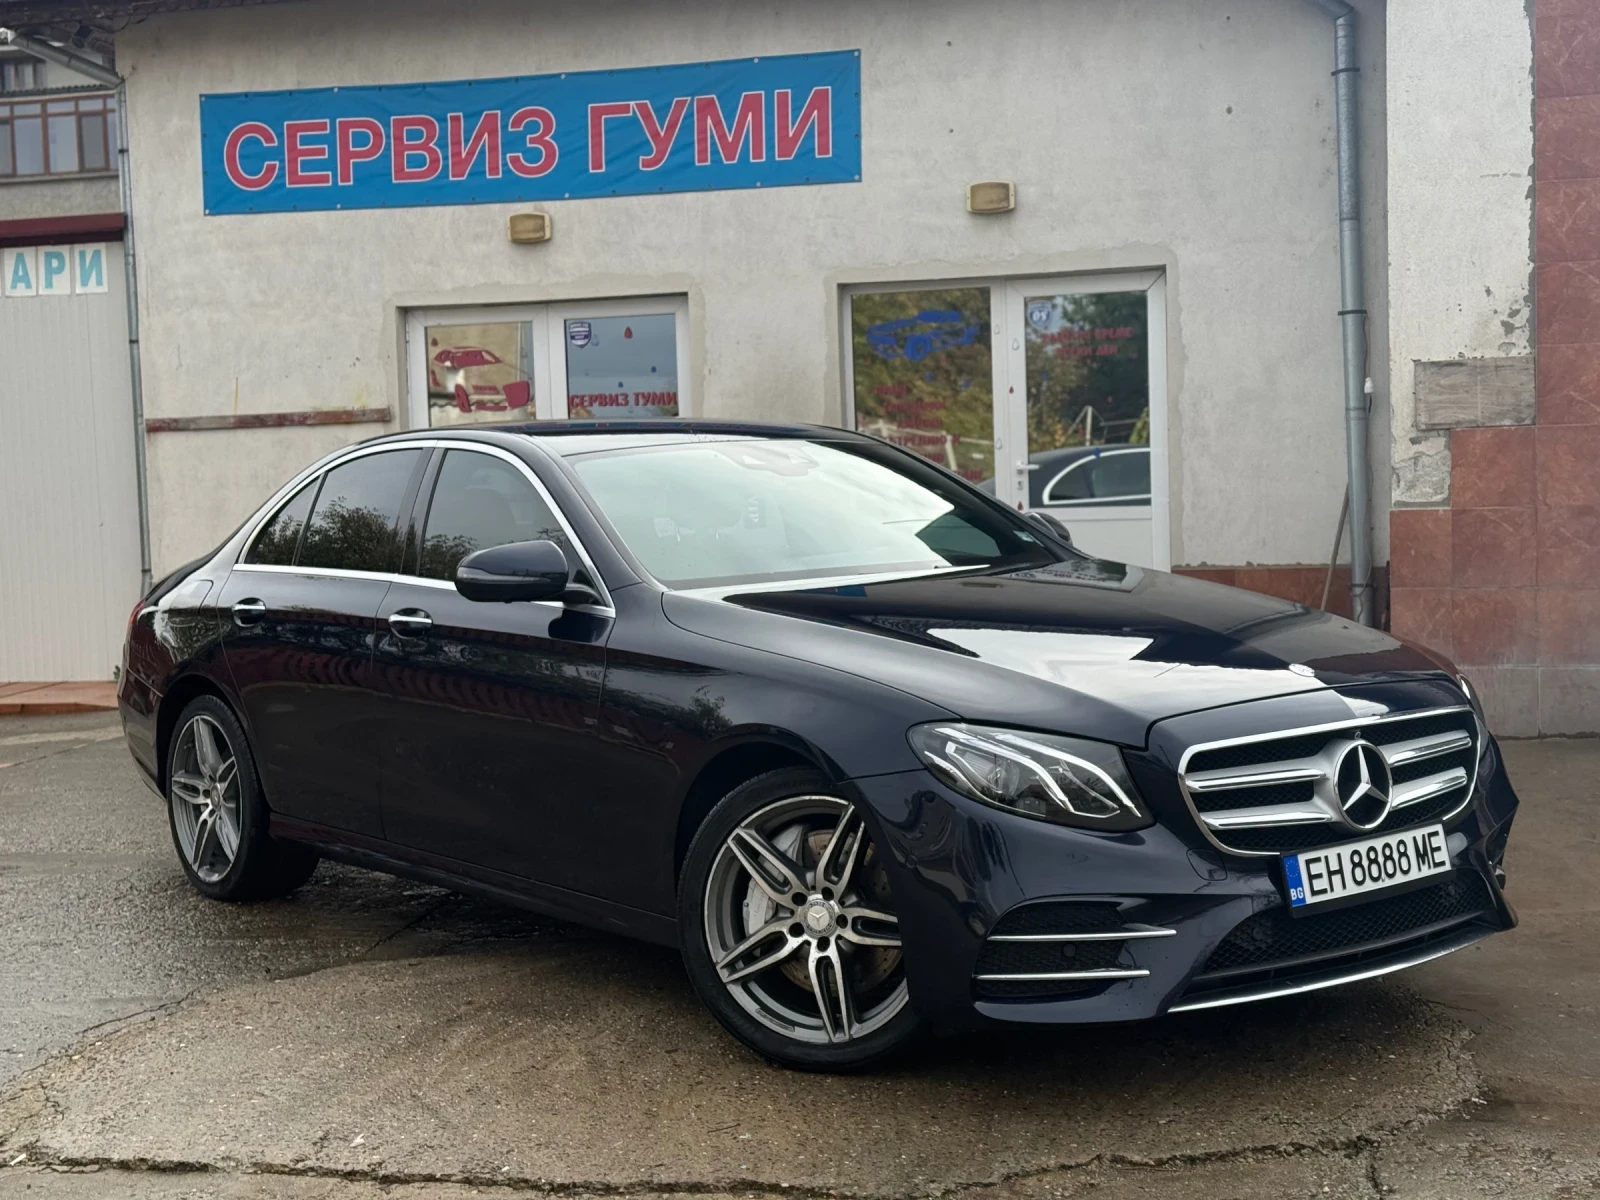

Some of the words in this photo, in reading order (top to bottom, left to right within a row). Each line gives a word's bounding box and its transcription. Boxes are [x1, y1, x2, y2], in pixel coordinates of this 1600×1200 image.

[223, 105, 560, 191] СЕРВИЗ
[588, 85, 833, 172] ГУМИ
[10, 249, 104, 290] АРИ
[568, 393, 629, 408] СЕРВИЗ
[1305, 853, 1346, 896] EH
[1350, 838, 1412, 886] 8888
[1413, 830, 1446, 872] ME
[1290, 887, 1304, 900] BG
